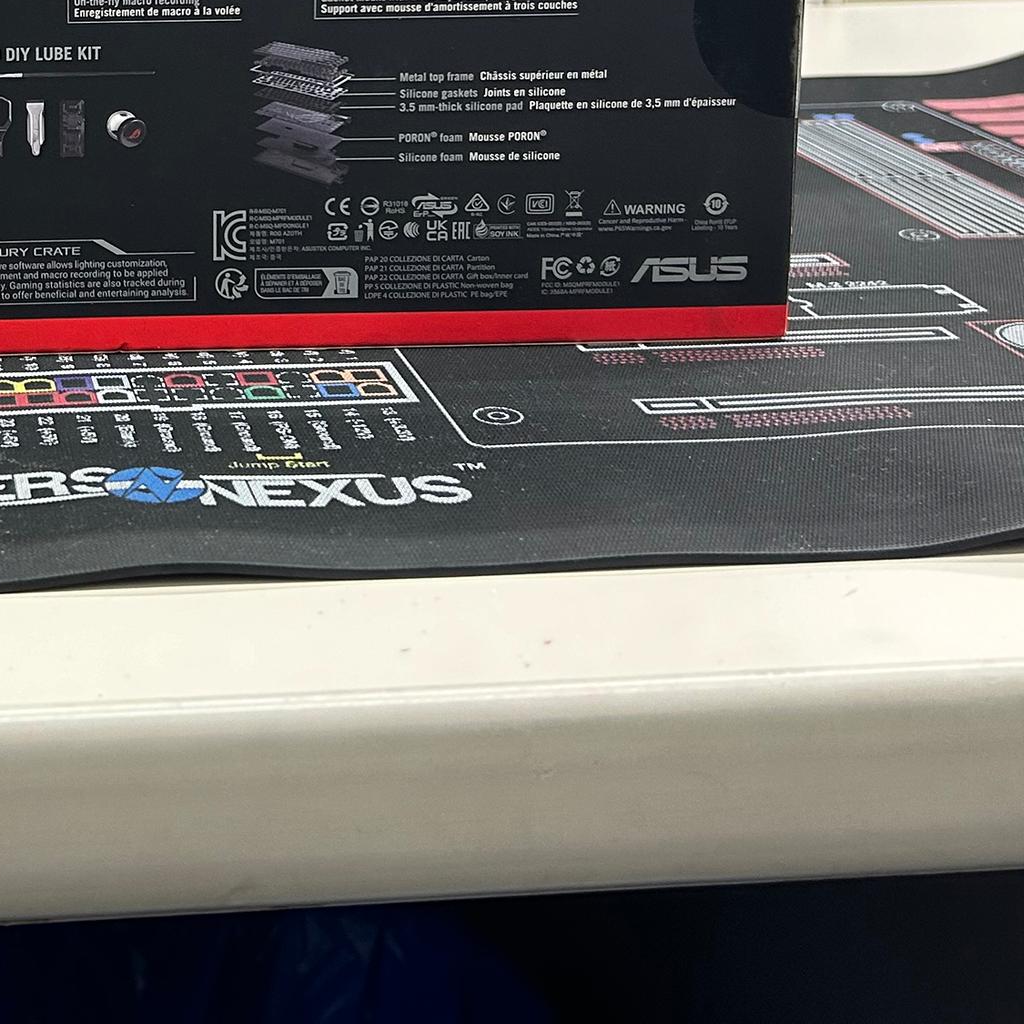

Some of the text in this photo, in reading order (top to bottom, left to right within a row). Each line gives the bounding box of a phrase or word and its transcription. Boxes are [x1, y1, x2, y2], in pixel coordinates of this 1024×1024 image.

[5, 47, 30, 61] DIY
[35, 46, 72, 61] LUBE
[77, 46, 101, 60] KIT
[399, 69, 607, 83] Metal top frame Châssis supérieur en métal
[624, 202, 686, 215] WARNING
[33, 246, 80, 256] CRATE
[630, 255, 749, 284] ASUS
